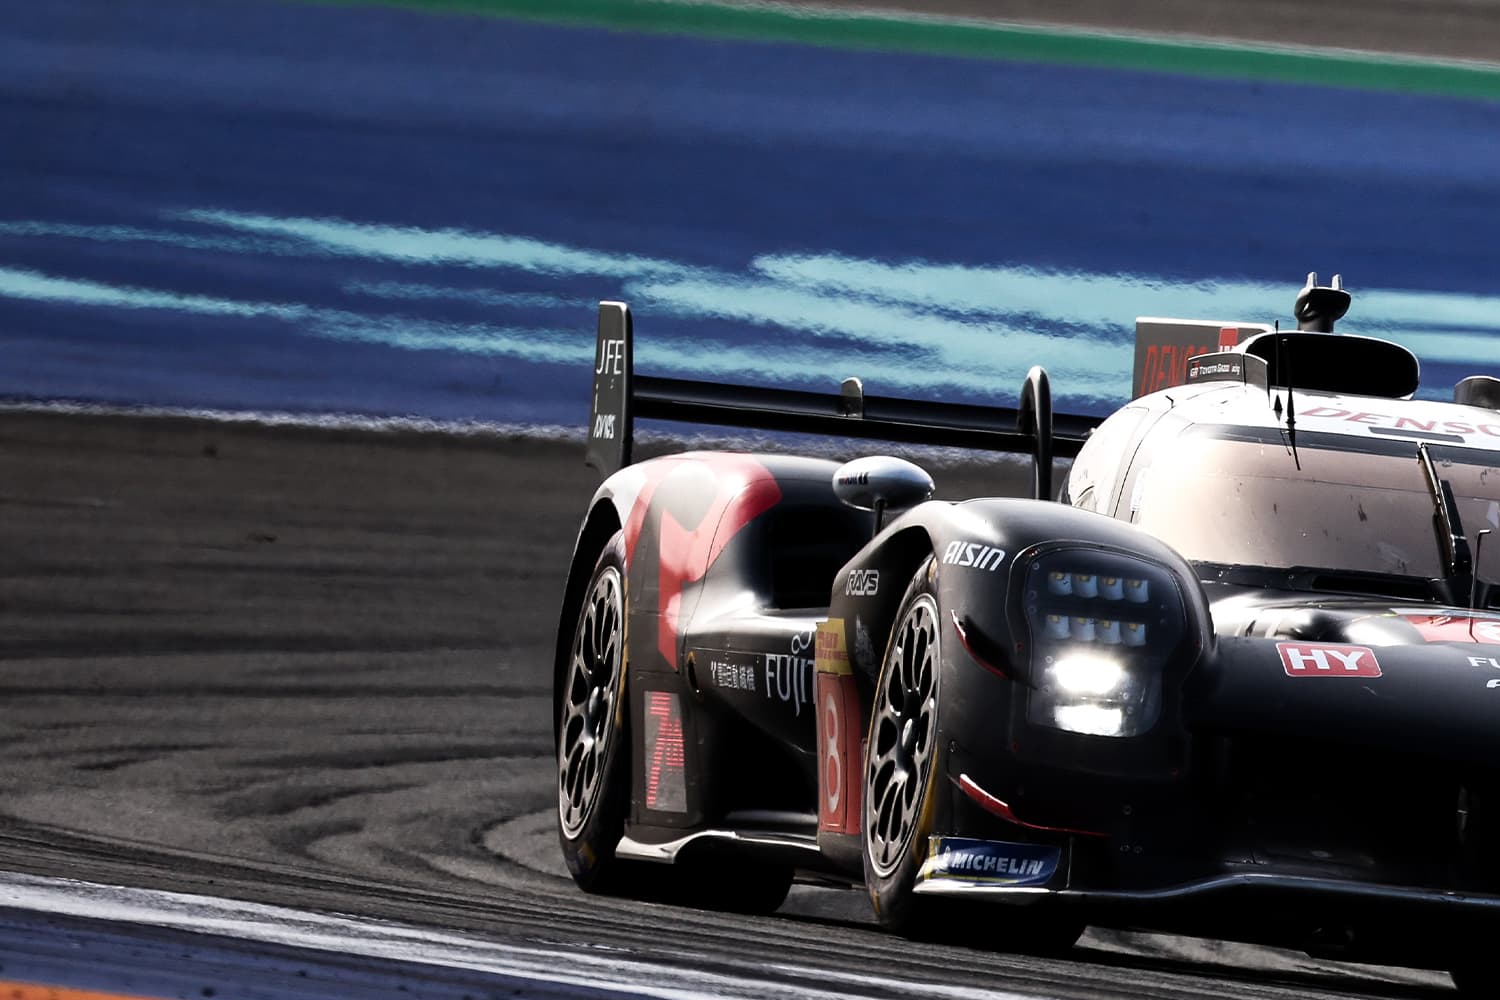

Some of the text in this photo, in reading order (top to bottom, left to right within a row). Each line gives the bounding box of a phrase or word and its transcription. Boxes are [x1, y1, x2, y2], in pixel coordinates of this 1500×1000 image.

[596, 340, 624, 374] JFE
[1140, 344, 1207, 396] DEN
[943, 541, 1006, 571] AISIN
[846, 569, 879, 596] RAYS
[1291, 648, 1365, 671] HY
[825, 692, 841, 814] 8
[952, 852, 1044, 875] MICHELIN
